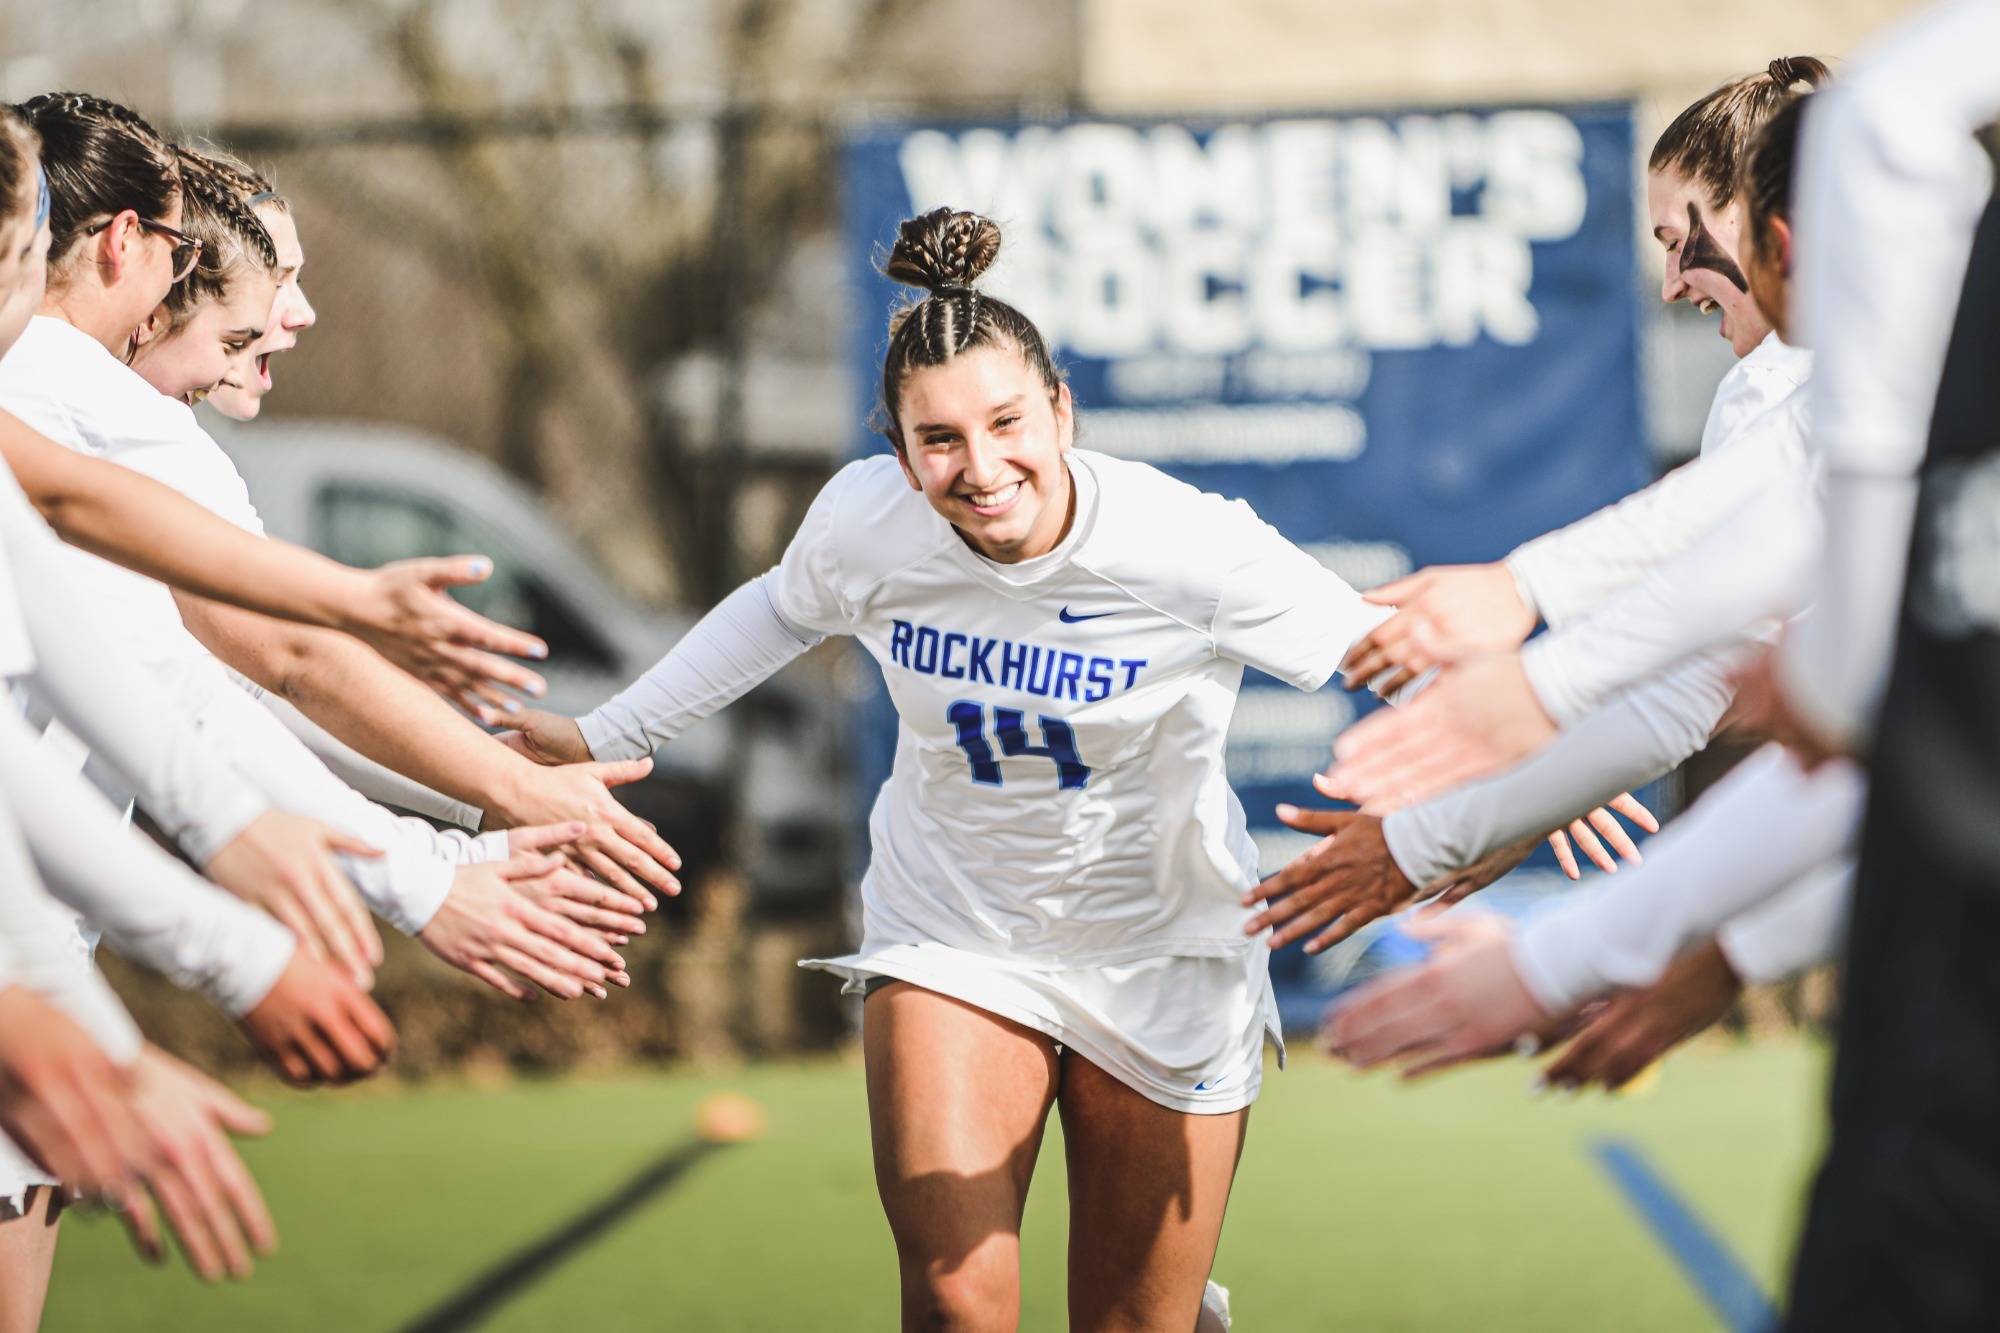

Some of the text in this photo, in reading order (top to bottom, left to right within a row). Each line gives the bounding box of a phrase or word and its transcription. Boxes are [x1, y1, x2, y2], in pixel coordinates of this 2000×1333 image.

[899, 110, 1588, 241] WOMEN'S
[891, 618, 1149, 703] ROCKHURST
[946, 699, 1091, 790] 14
